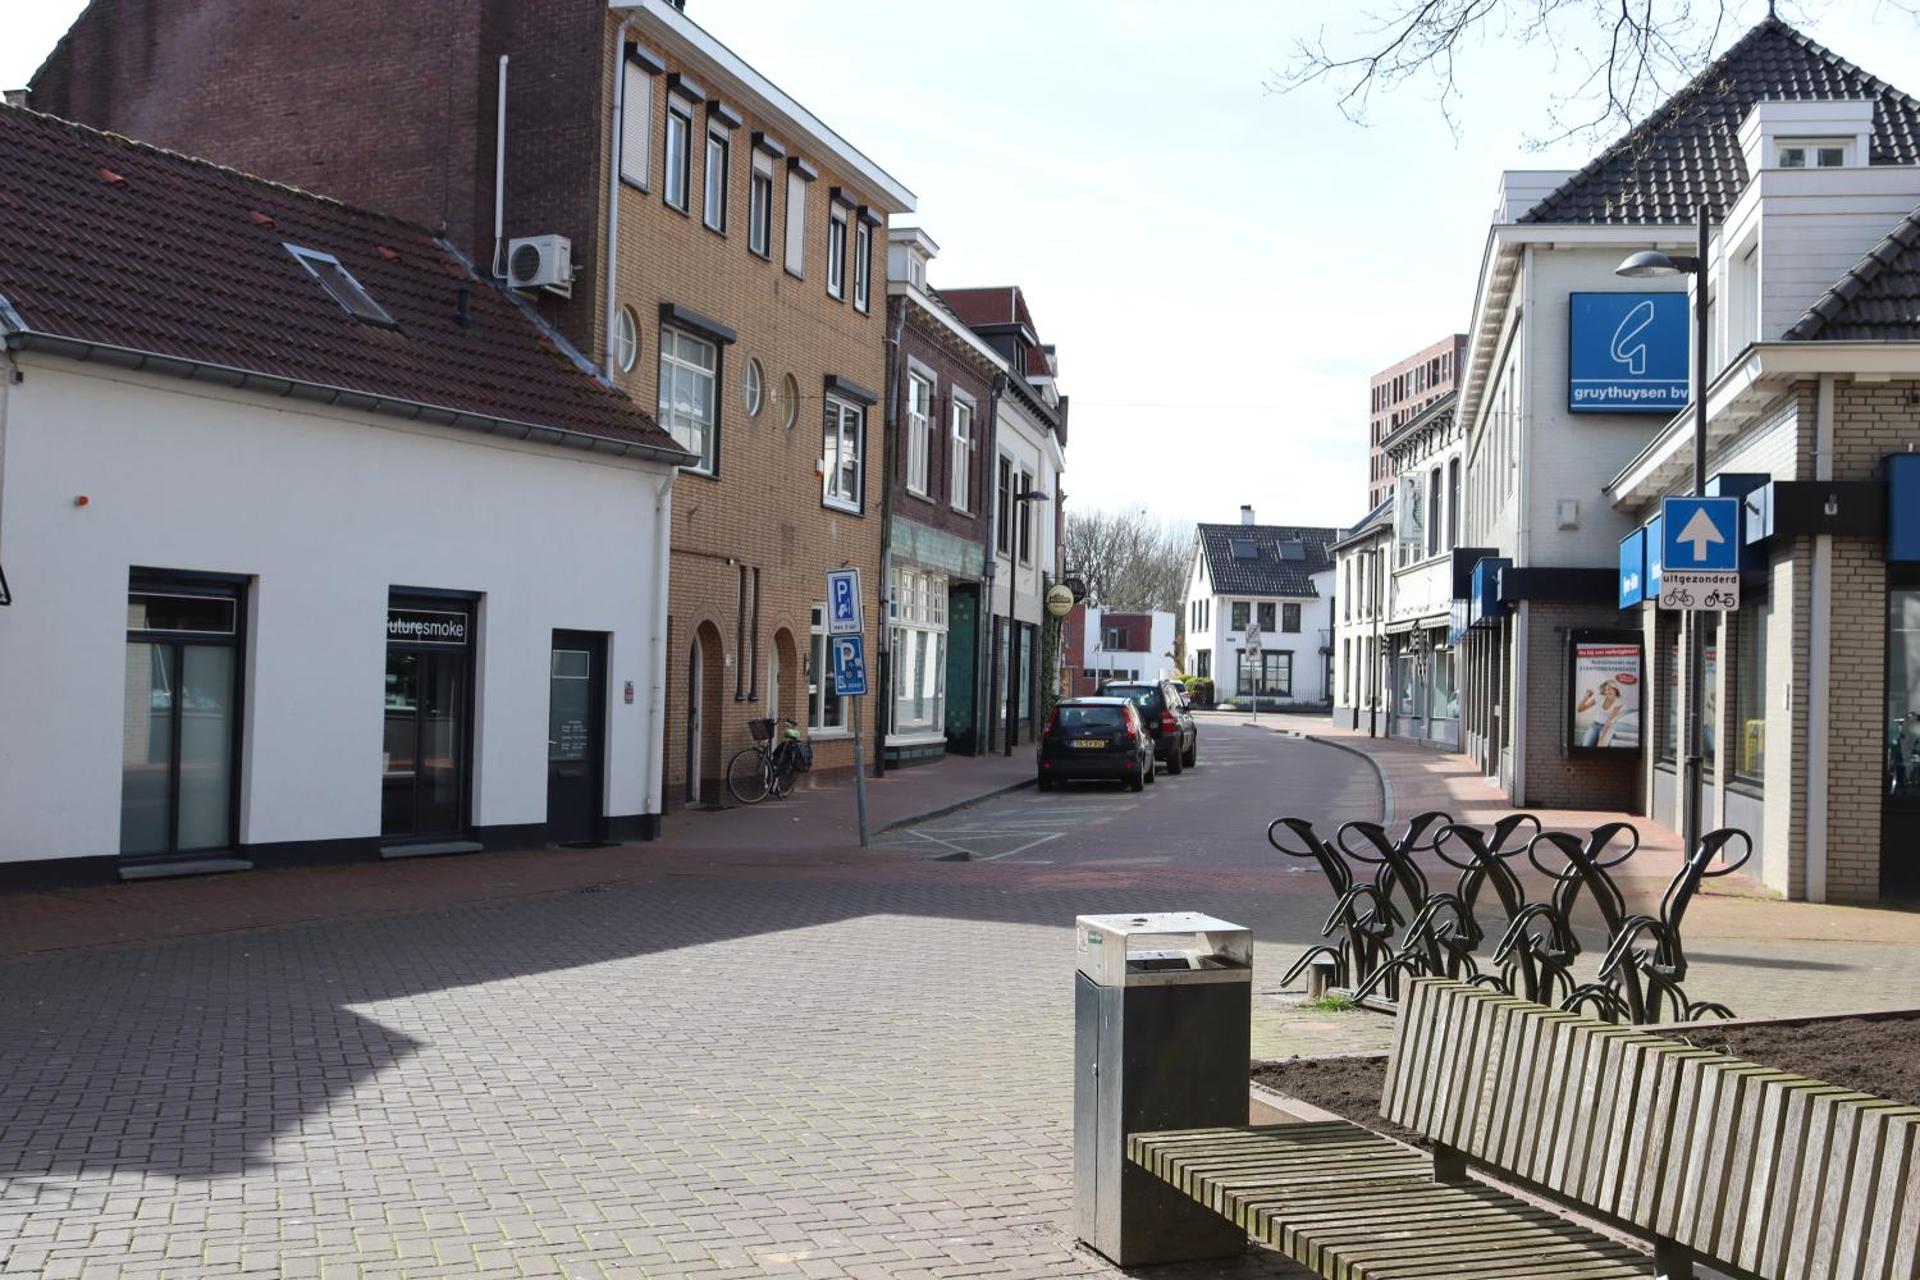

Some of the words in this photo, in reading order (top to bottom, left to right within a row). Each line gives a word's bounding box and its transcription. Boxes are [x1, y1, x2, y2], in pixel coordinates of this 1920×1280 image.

[1574, 386, 1666, 400] gruythuysen
[1663, 574, 1737, 585] uitgezonderd
[837, 581, 848, 603] P
[387, 617, 464, 637] uturesmoke
[841, 642, 856, 671] P
